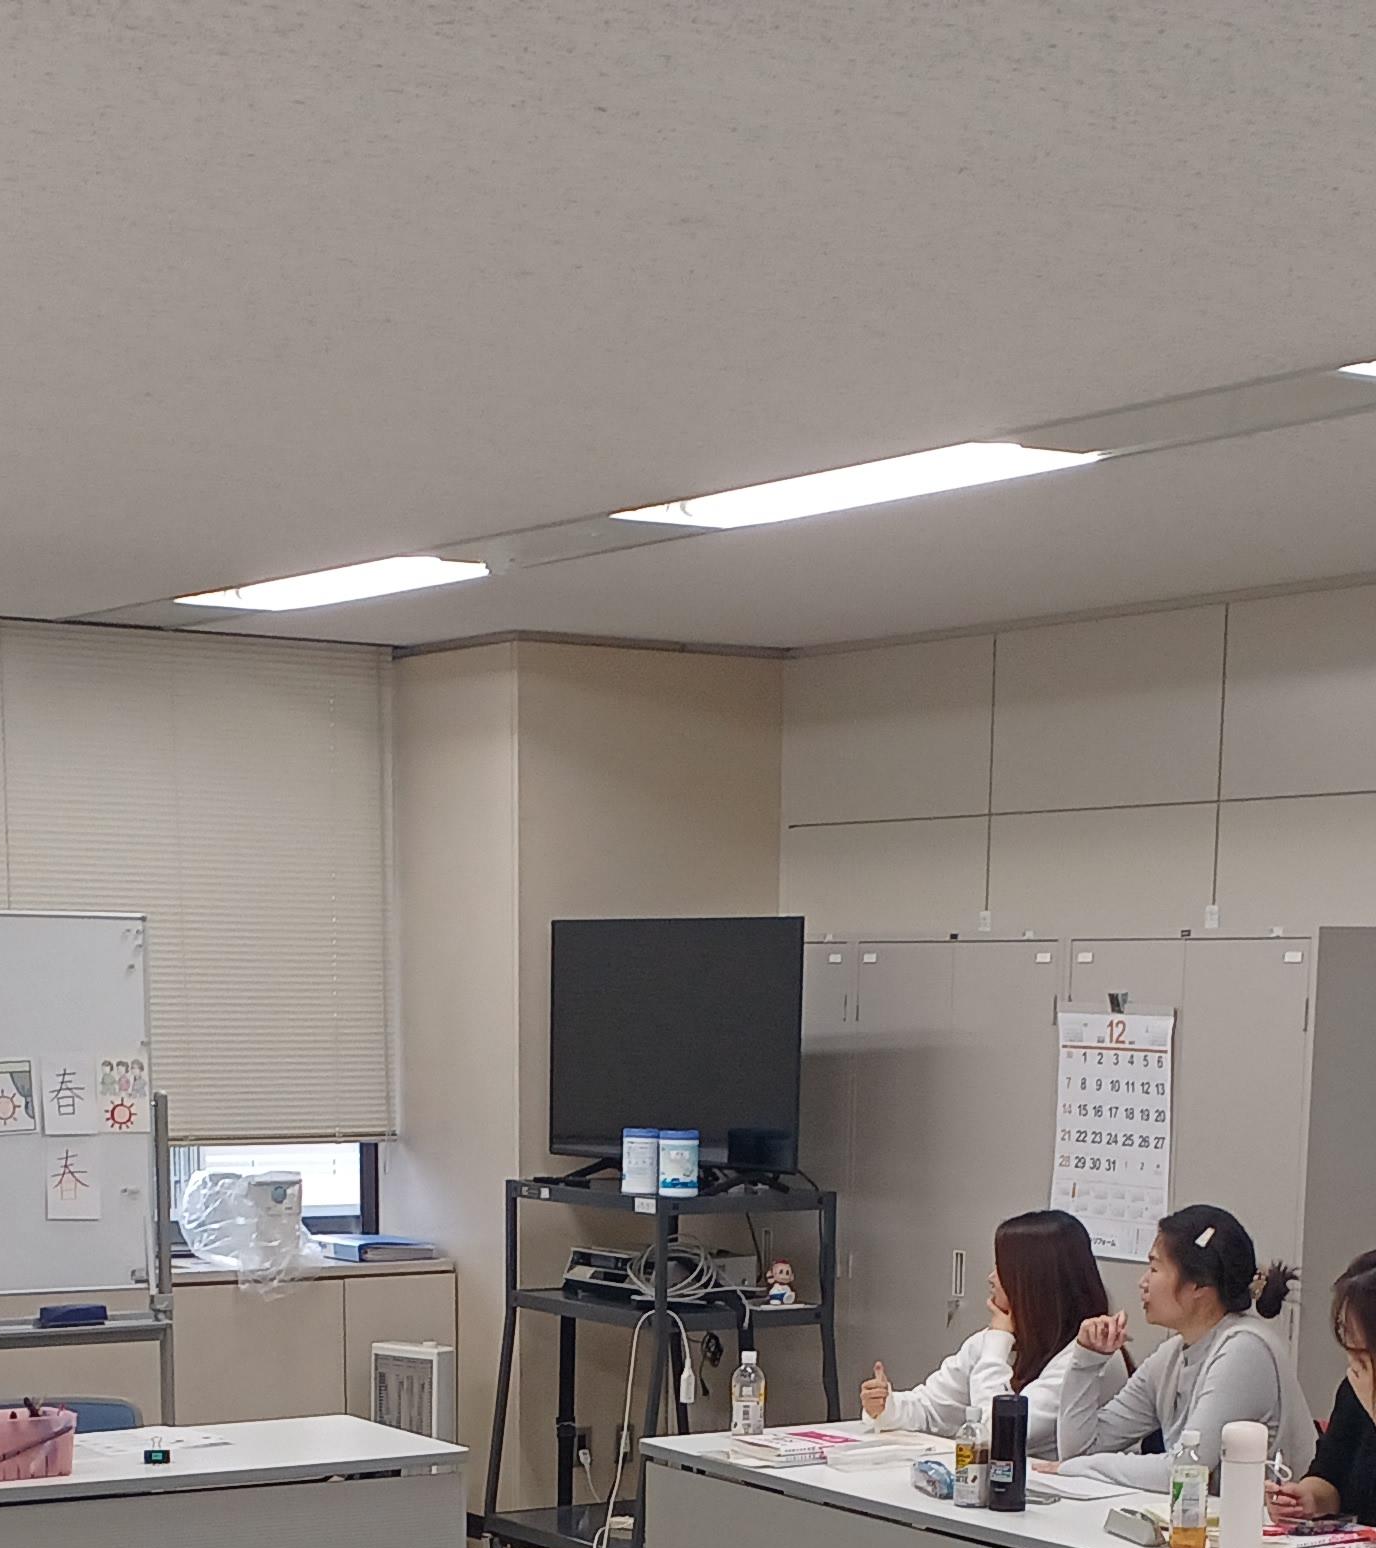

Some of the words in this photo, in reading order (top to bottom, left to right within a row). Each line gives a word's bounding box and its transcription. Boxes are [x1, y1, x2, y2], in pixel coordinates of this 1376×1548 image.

[1106, 1020, 1126, 1045] 12
[1082, 1052, 1087, 1064] 1
[1097, 1053, 1104, 1065] 2
[1112, 1053, 1119, 1065] 3
[1128, 1054, 1134, 1066] 4
[1142, 1055, 1149, 1067] 5
[1157, 1056, 1163, 1069] 6
[49, 1068, 85, 1116] 春
[1066, 1077, 1072, 1089] 7
[1080, 1077, 1087, 1090] 8
[1095, 1078, 1102, 1091] 9
[1110, 1079, 1120, 1092] 10
[1125, 1080, 1135, 1094] 11
[1140, 1081, 1151, 1095] 12
[1155, 1083, 1165, 1096] 13
[1078, 1104, 1088, 1117] 15
[1092, 1105, 1103, 1118] 16
[1108, 1106, 1118, 1119] 17
[1124, 1107, 1134, 1121] 18
[1140, 1108, 1150, 1121] 19
[1154, 1109, 1166, 1123] 20
[1076, 1130, 1088, 1143] 22
[1091, 1131, 1102, 1144] 23
[1106, 1132, 1118, 1146] 24
[1122, 1133, 1134, 1147] 25
[1138, 1134, 1150, 1149] 26
[1154, 1136, 1165, 1150] 27
[1074, 1155, 1086, 1169] 29
[1089, 1156, 1101, 1170] 30
[1105, 1157, 1116, 1171] 31
